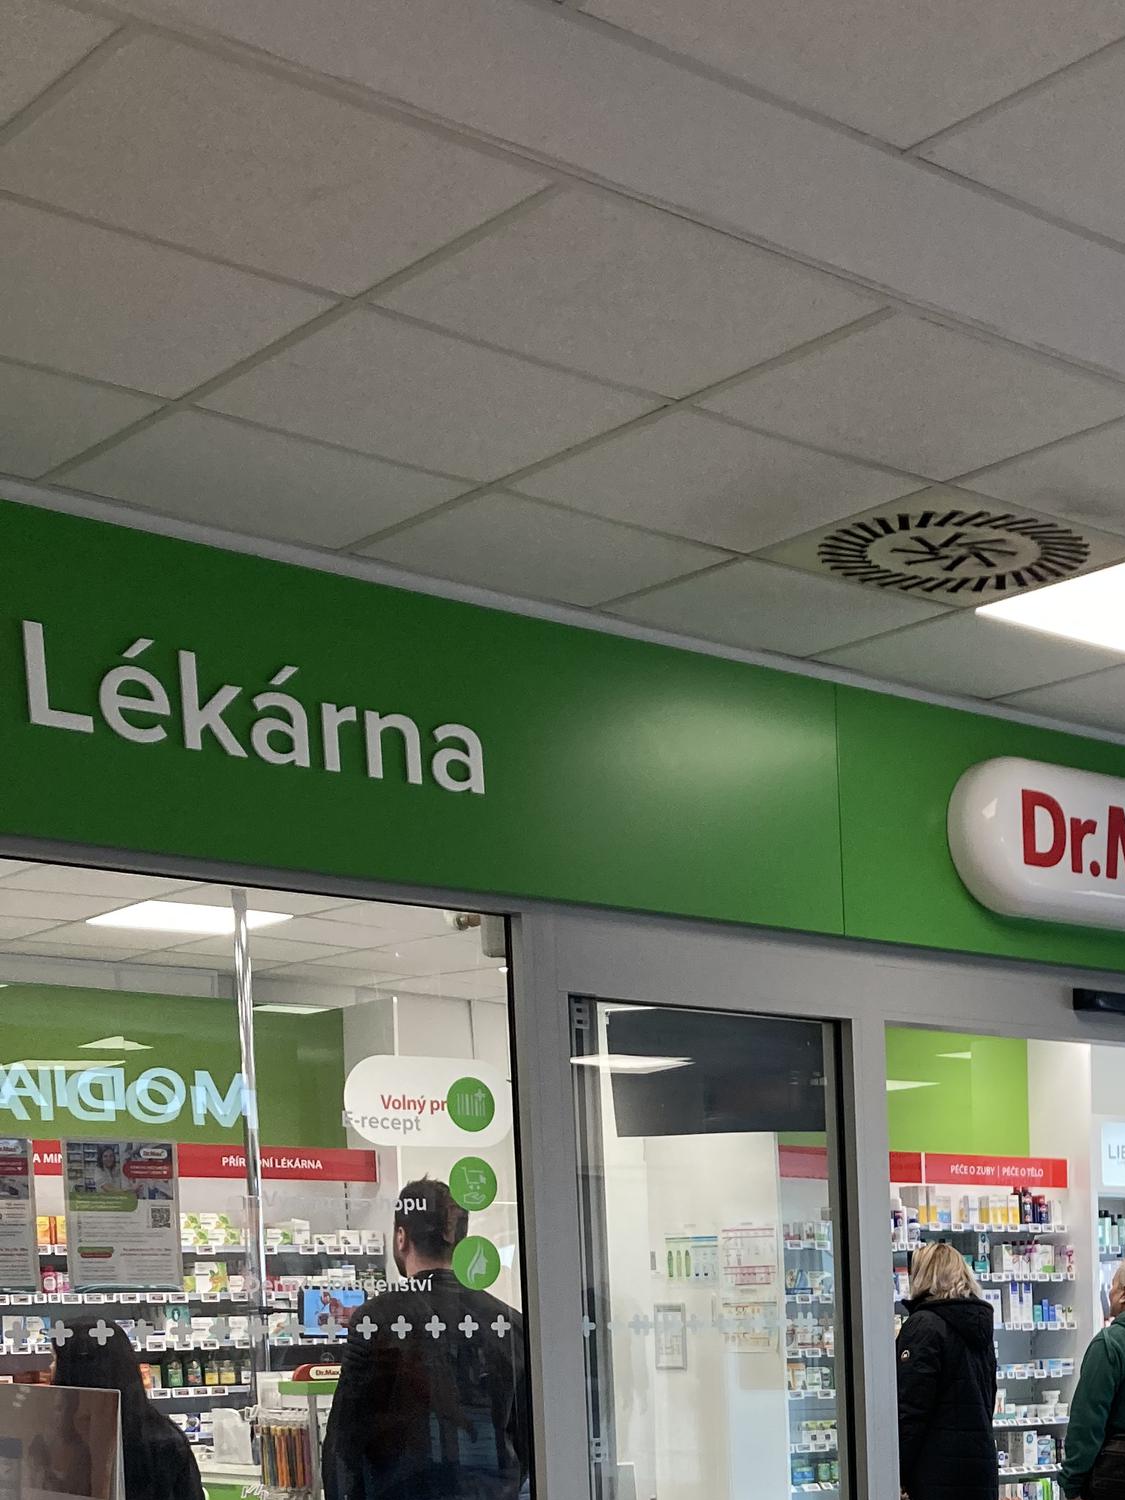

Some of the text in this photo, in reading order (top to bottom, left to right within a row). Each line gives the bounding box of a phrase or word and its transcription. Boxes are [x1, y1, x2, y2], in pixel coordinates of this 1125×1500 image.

[22, 619, 486, 795] Lékárna
[381, 1094, 427, 1115] Volný
[222, 1155, 323, 1171] PŘÍRNÍ LÉKÁRNA
[951, 1163, 968, 1175] PÉČE
